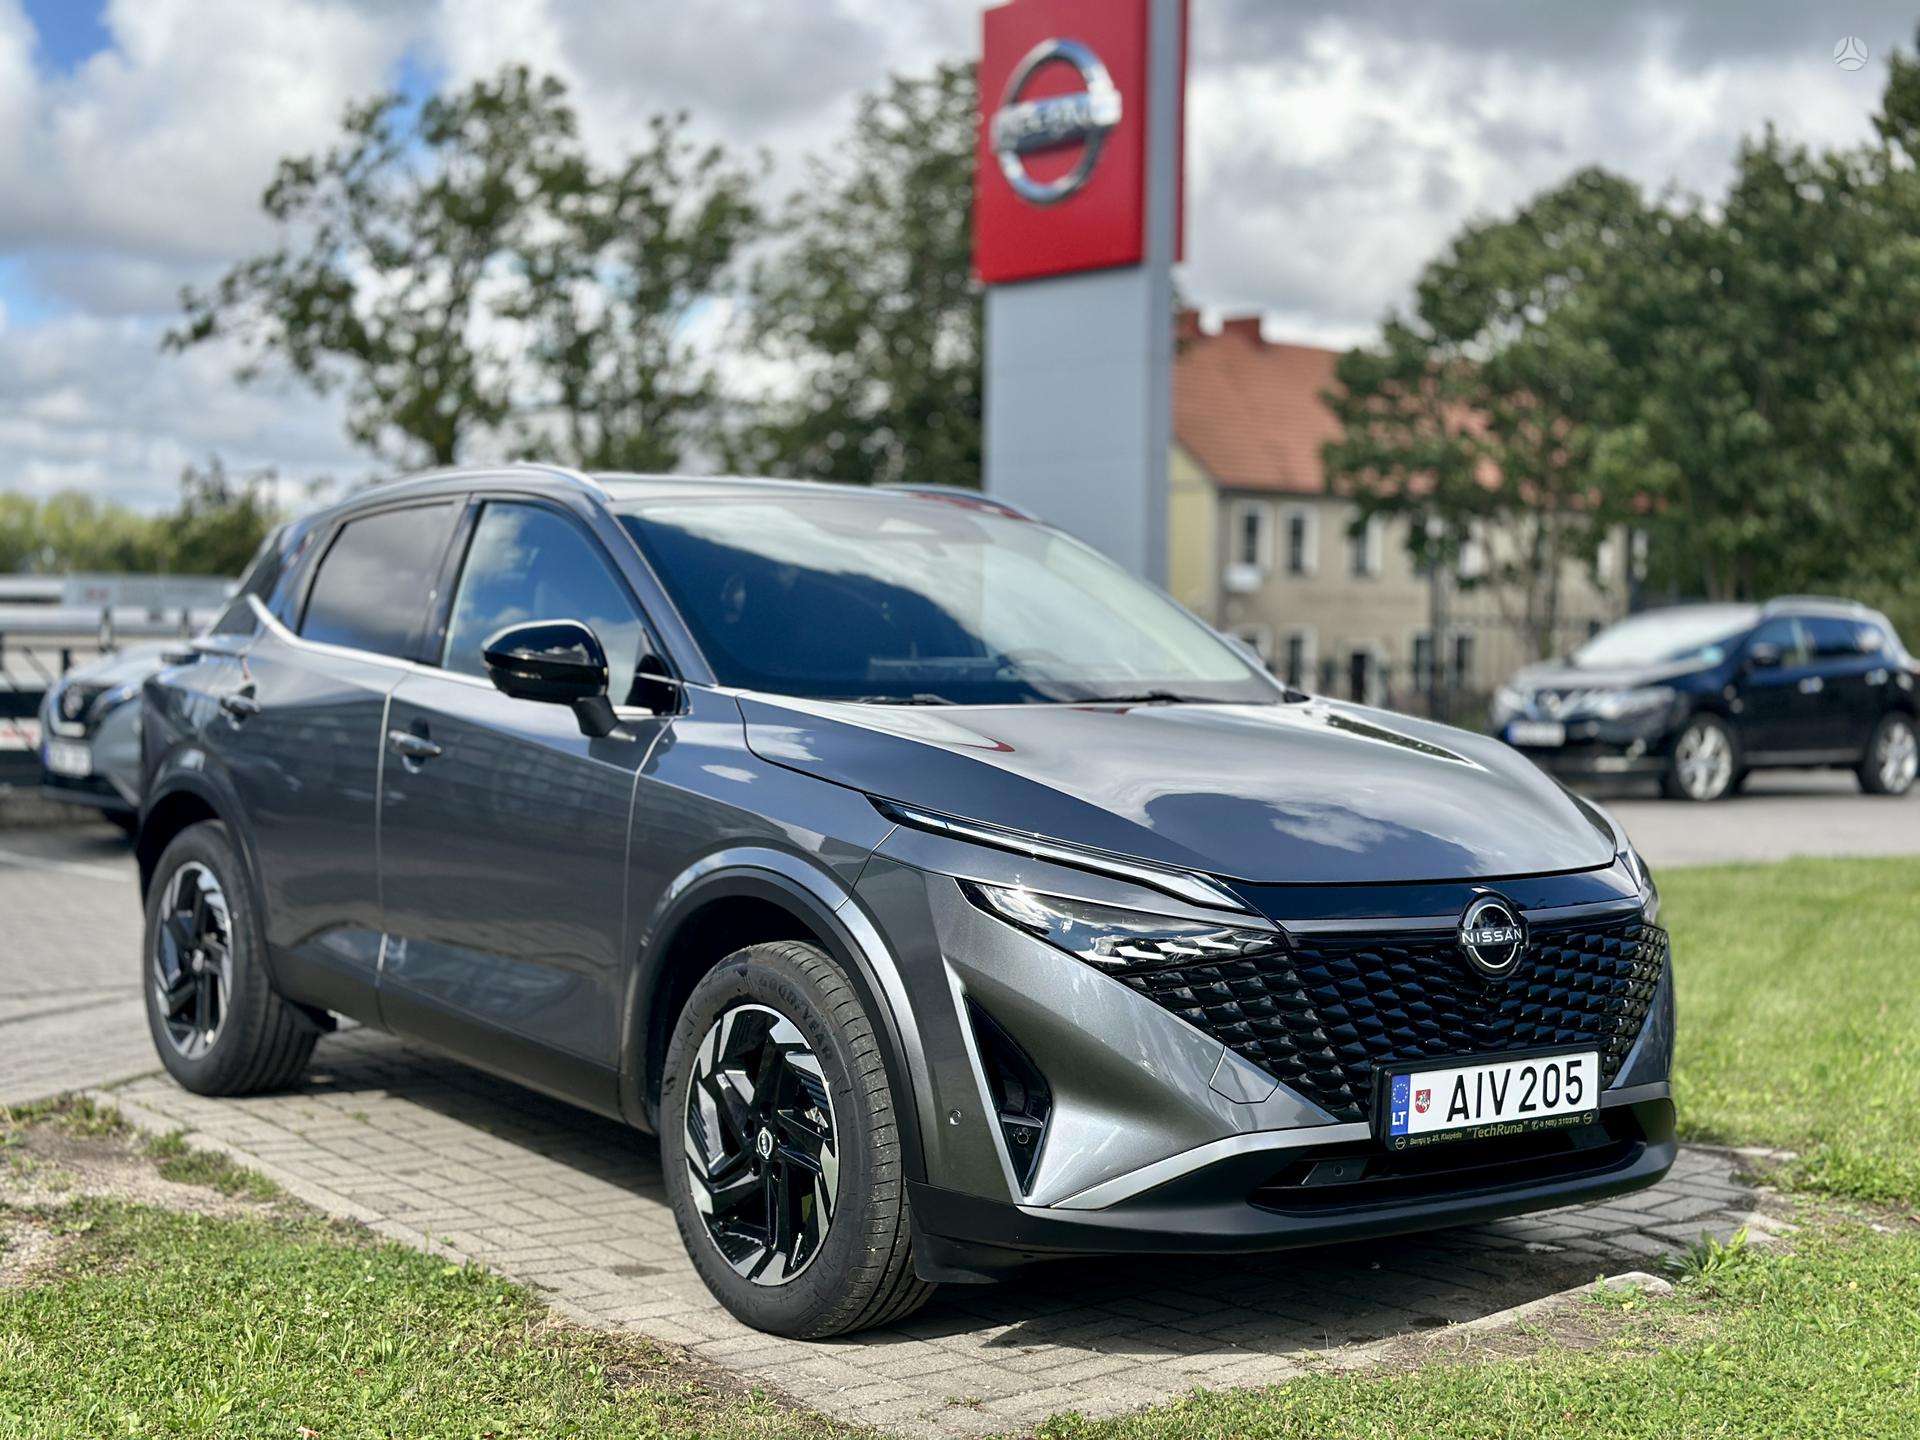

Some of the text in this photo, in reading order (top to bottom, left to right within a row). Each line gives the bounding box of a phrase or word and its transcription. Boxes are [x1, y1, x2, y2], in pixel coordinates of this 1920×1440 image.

[1462, 929, 1521, 943] NISSAN
[1446, 1059, 1582, 1122] AIV 205
[1392, 1111, 1406, 1126] LT
[1467, 1120, 1529, 1139] "TechRuna"
